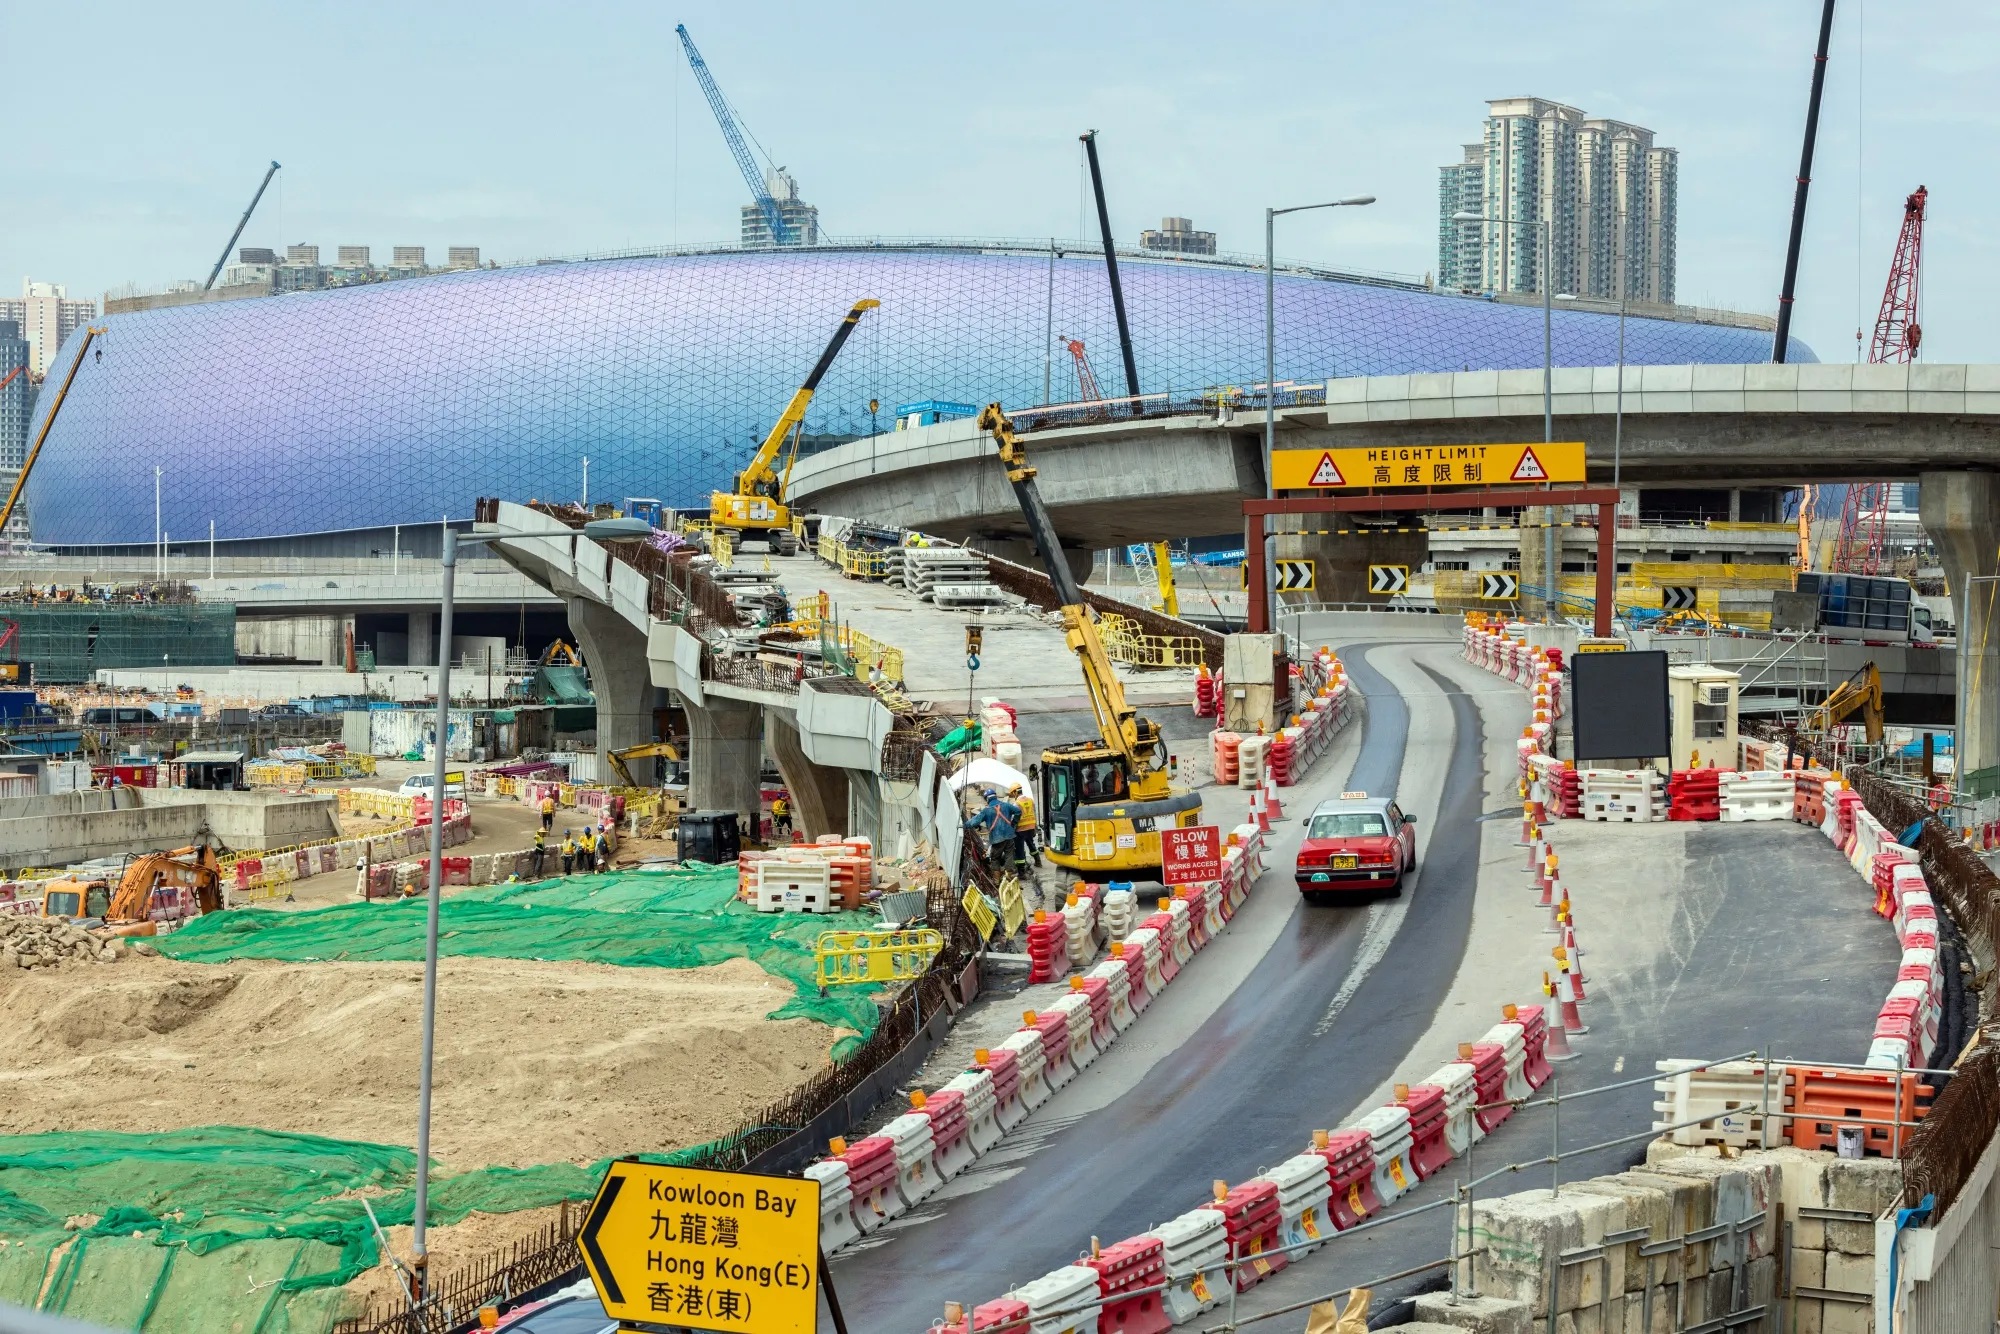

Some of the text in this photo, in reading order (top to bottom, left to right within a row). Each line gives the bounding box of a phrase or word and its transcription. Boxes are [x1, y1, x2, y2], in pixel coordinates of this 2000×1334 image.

[1368, 447, 1488, 462] HEIGHT LIMIT
[1318, 470, 1336, 478] 4.6m
[1373, 462, 1483, 484] 高度限制
[1518, 464, 1538, 472] 4.6m
[1172, 831, 1208, 844] SLOW
[1174, 843, 1209, 860] 慢駛
[1167, 862, 1191, 871] WORKS
[1171, 869, 1216, 881] 工地出入口
[649, 1179, 797, 1218] Kowloon Bay
[648, 1210, 740, 1249] 九龍灣
[647, 1250, 811, 1290] Hong Kong(E)
[647, 1282, 752, 1323] 香港(東)
